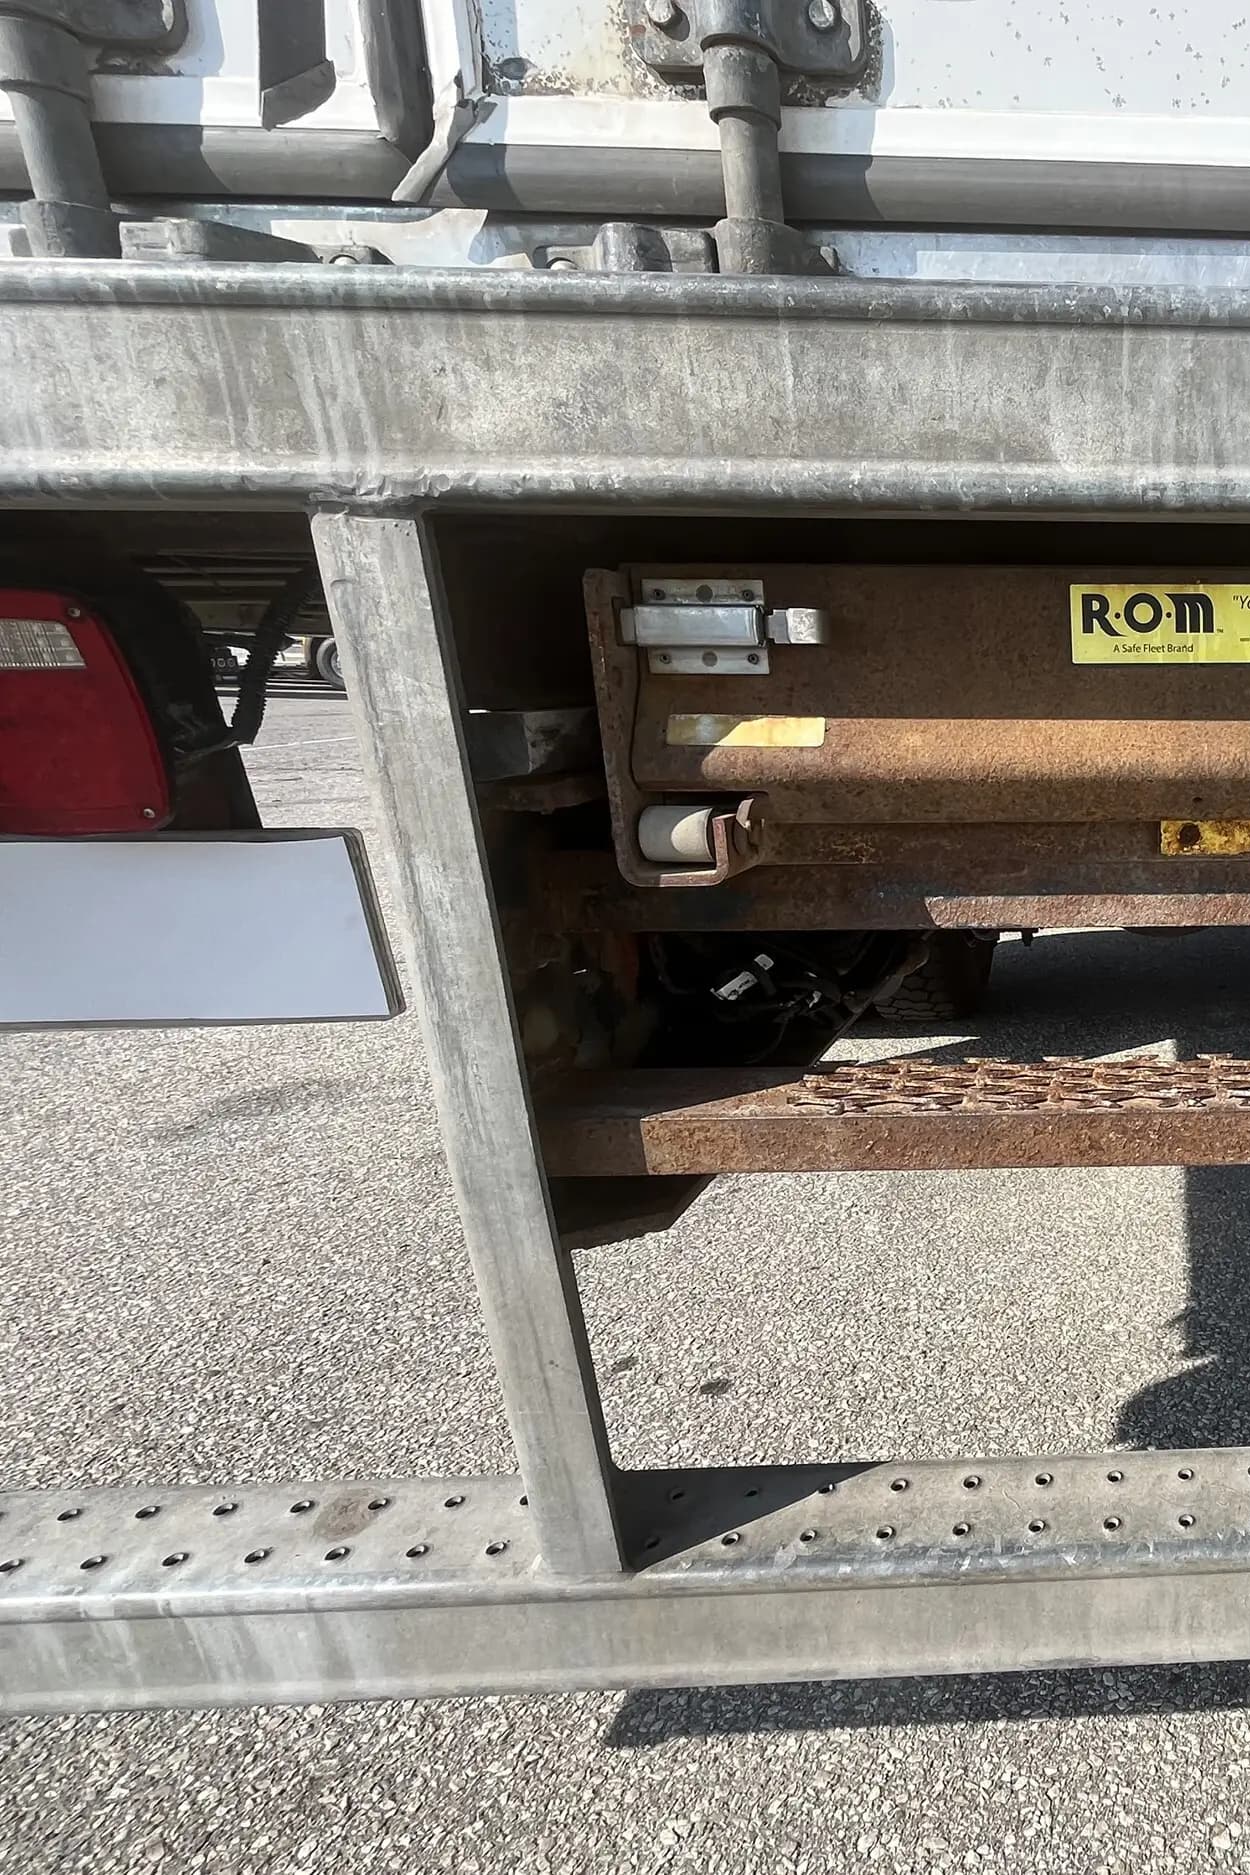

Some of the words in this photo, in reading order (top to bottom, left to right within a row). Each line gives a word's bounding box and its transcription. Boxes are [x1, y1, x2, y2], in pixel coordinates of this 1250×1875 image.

[1113, 644, 1120, 653] A
[1122, 643, 1141, 653] Safe
[1143, 643, 1165, 653] Fleet
[1167, 643, 1194, 653] Brand
